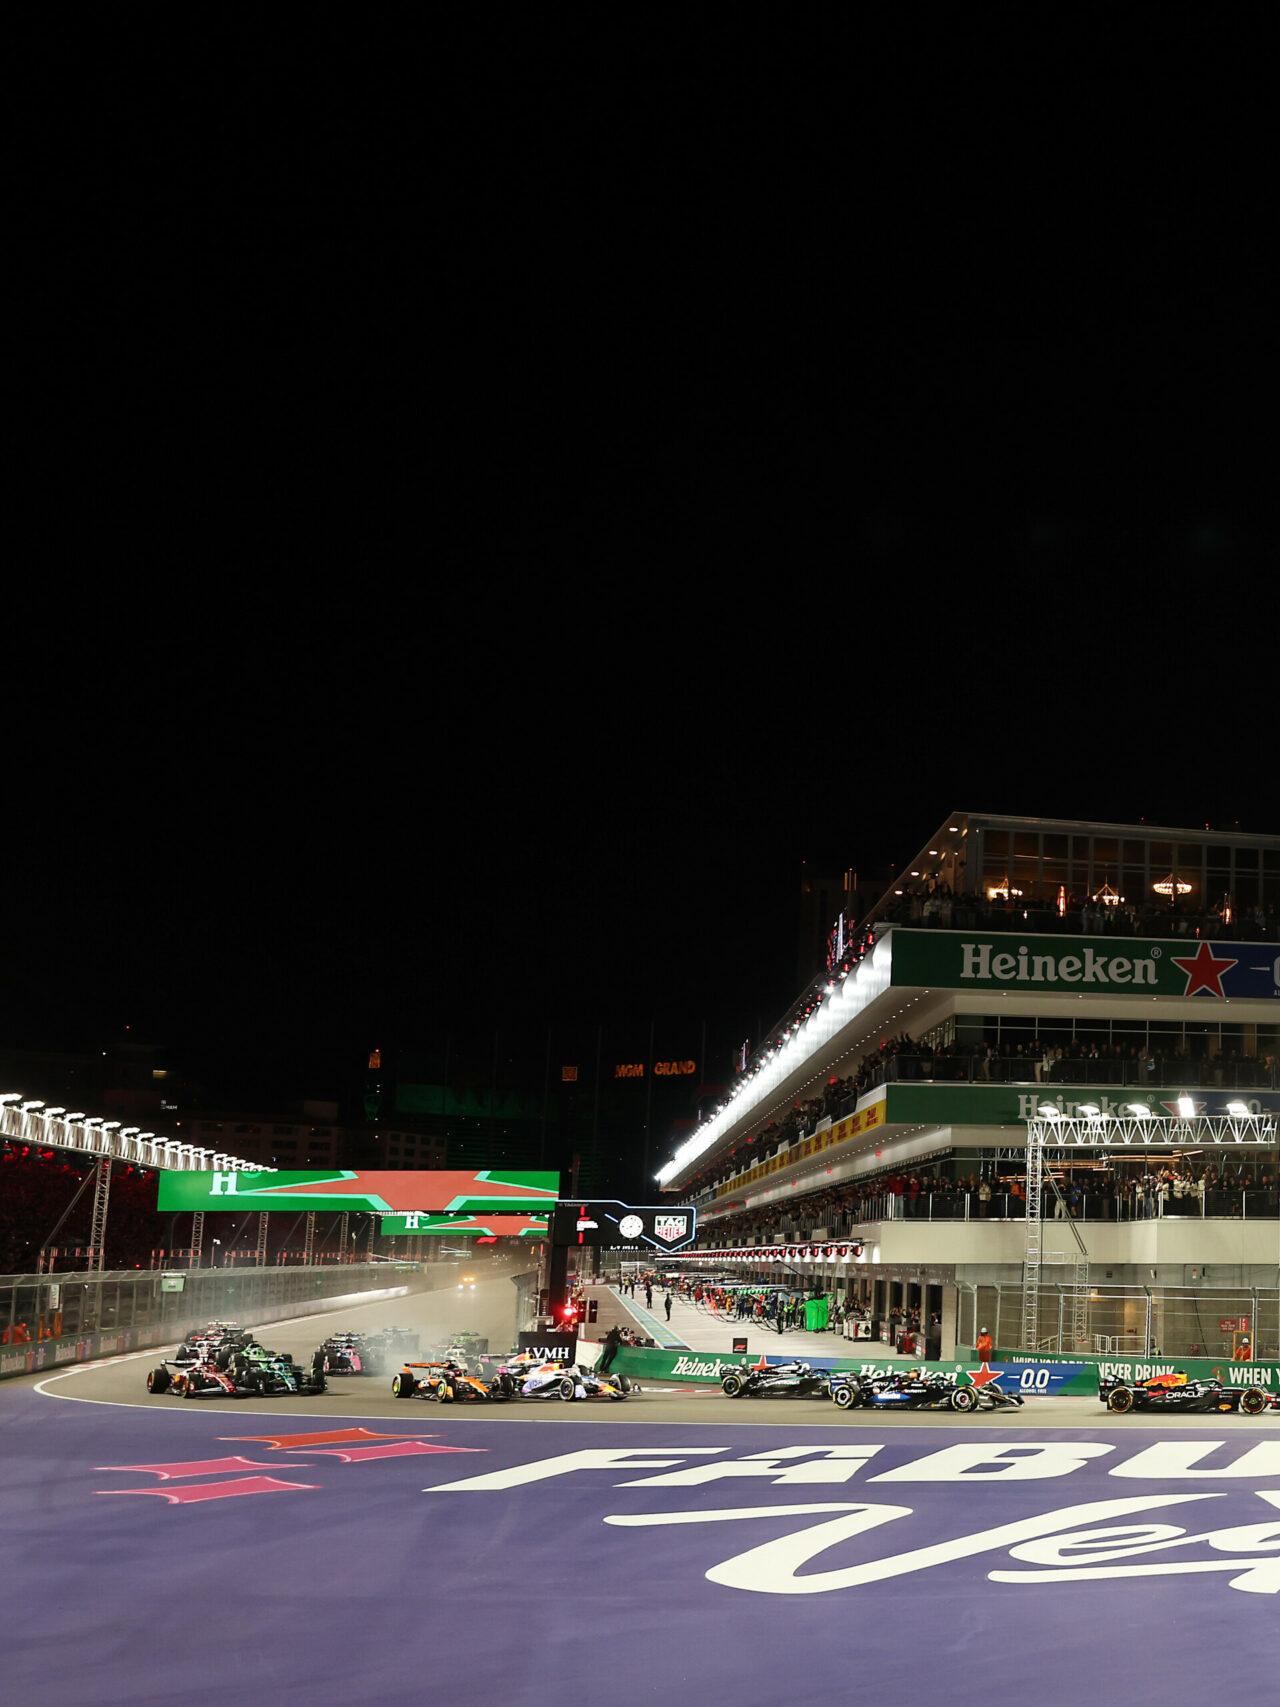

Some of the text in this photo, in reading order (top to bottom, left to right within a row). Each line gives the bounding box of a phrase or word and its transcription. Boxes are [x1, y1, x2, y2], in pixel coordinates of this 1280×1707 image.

[960, 944, 1159, 985] Heineken
[615, 1060, 696, 1078] MGM GRAND
[1017, 1094, 1152, 1119] Hinke
[209, 1172, 239, 1195] H
[405, 1215, 420, 1229] H
[658, 1217, 686, 1227] TAG
[671, 1356, 727, 1377] Heinek
[1098, 1362, 1175, 1381] NEVER DRINK
[1229, 1367, 1272, 1385] WHEN
[1020, 1368, 1050, 1389] 0.0
[1165, 1390, 1205, 1399] ORACLE
